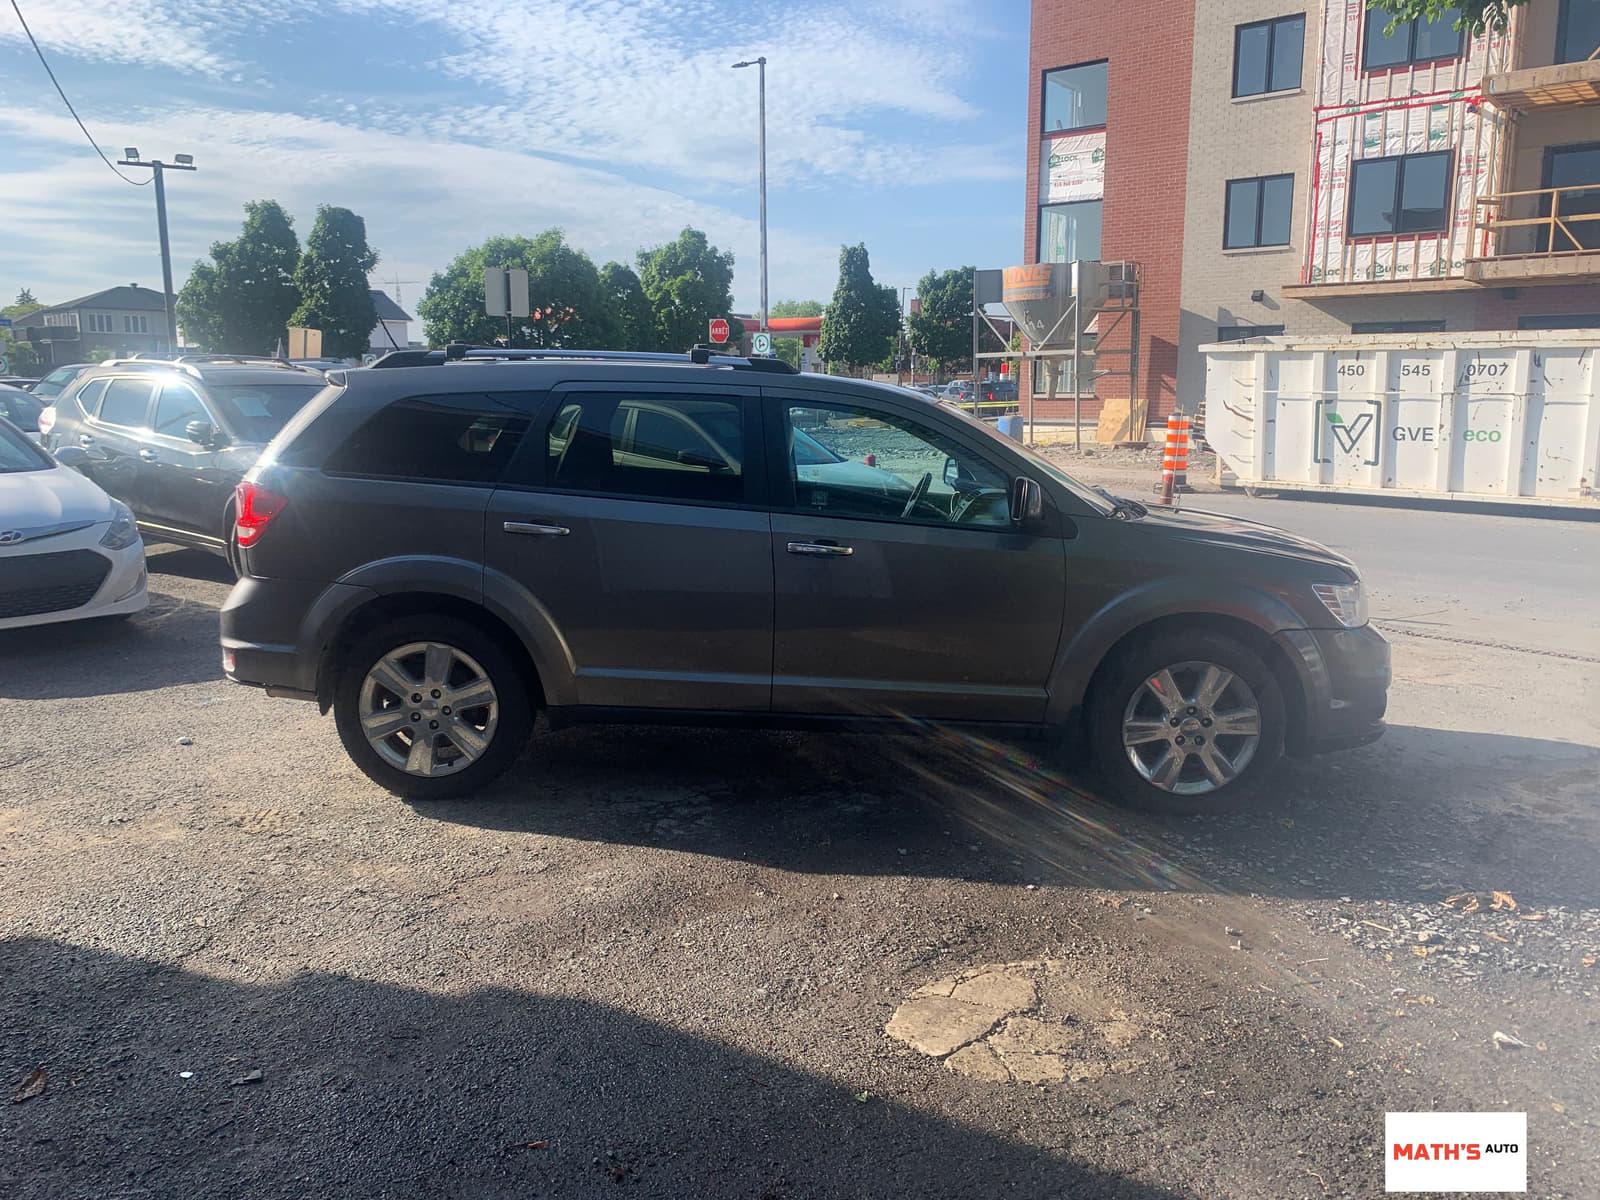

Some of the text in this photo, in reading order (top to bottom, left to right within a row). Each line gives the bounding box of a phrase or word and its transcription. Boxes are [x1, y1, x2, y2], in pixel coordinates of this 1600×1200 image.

[1337, 364, 1509, 376] 450 545 0707
[1392, 427, 1502, 442] GVE eco
